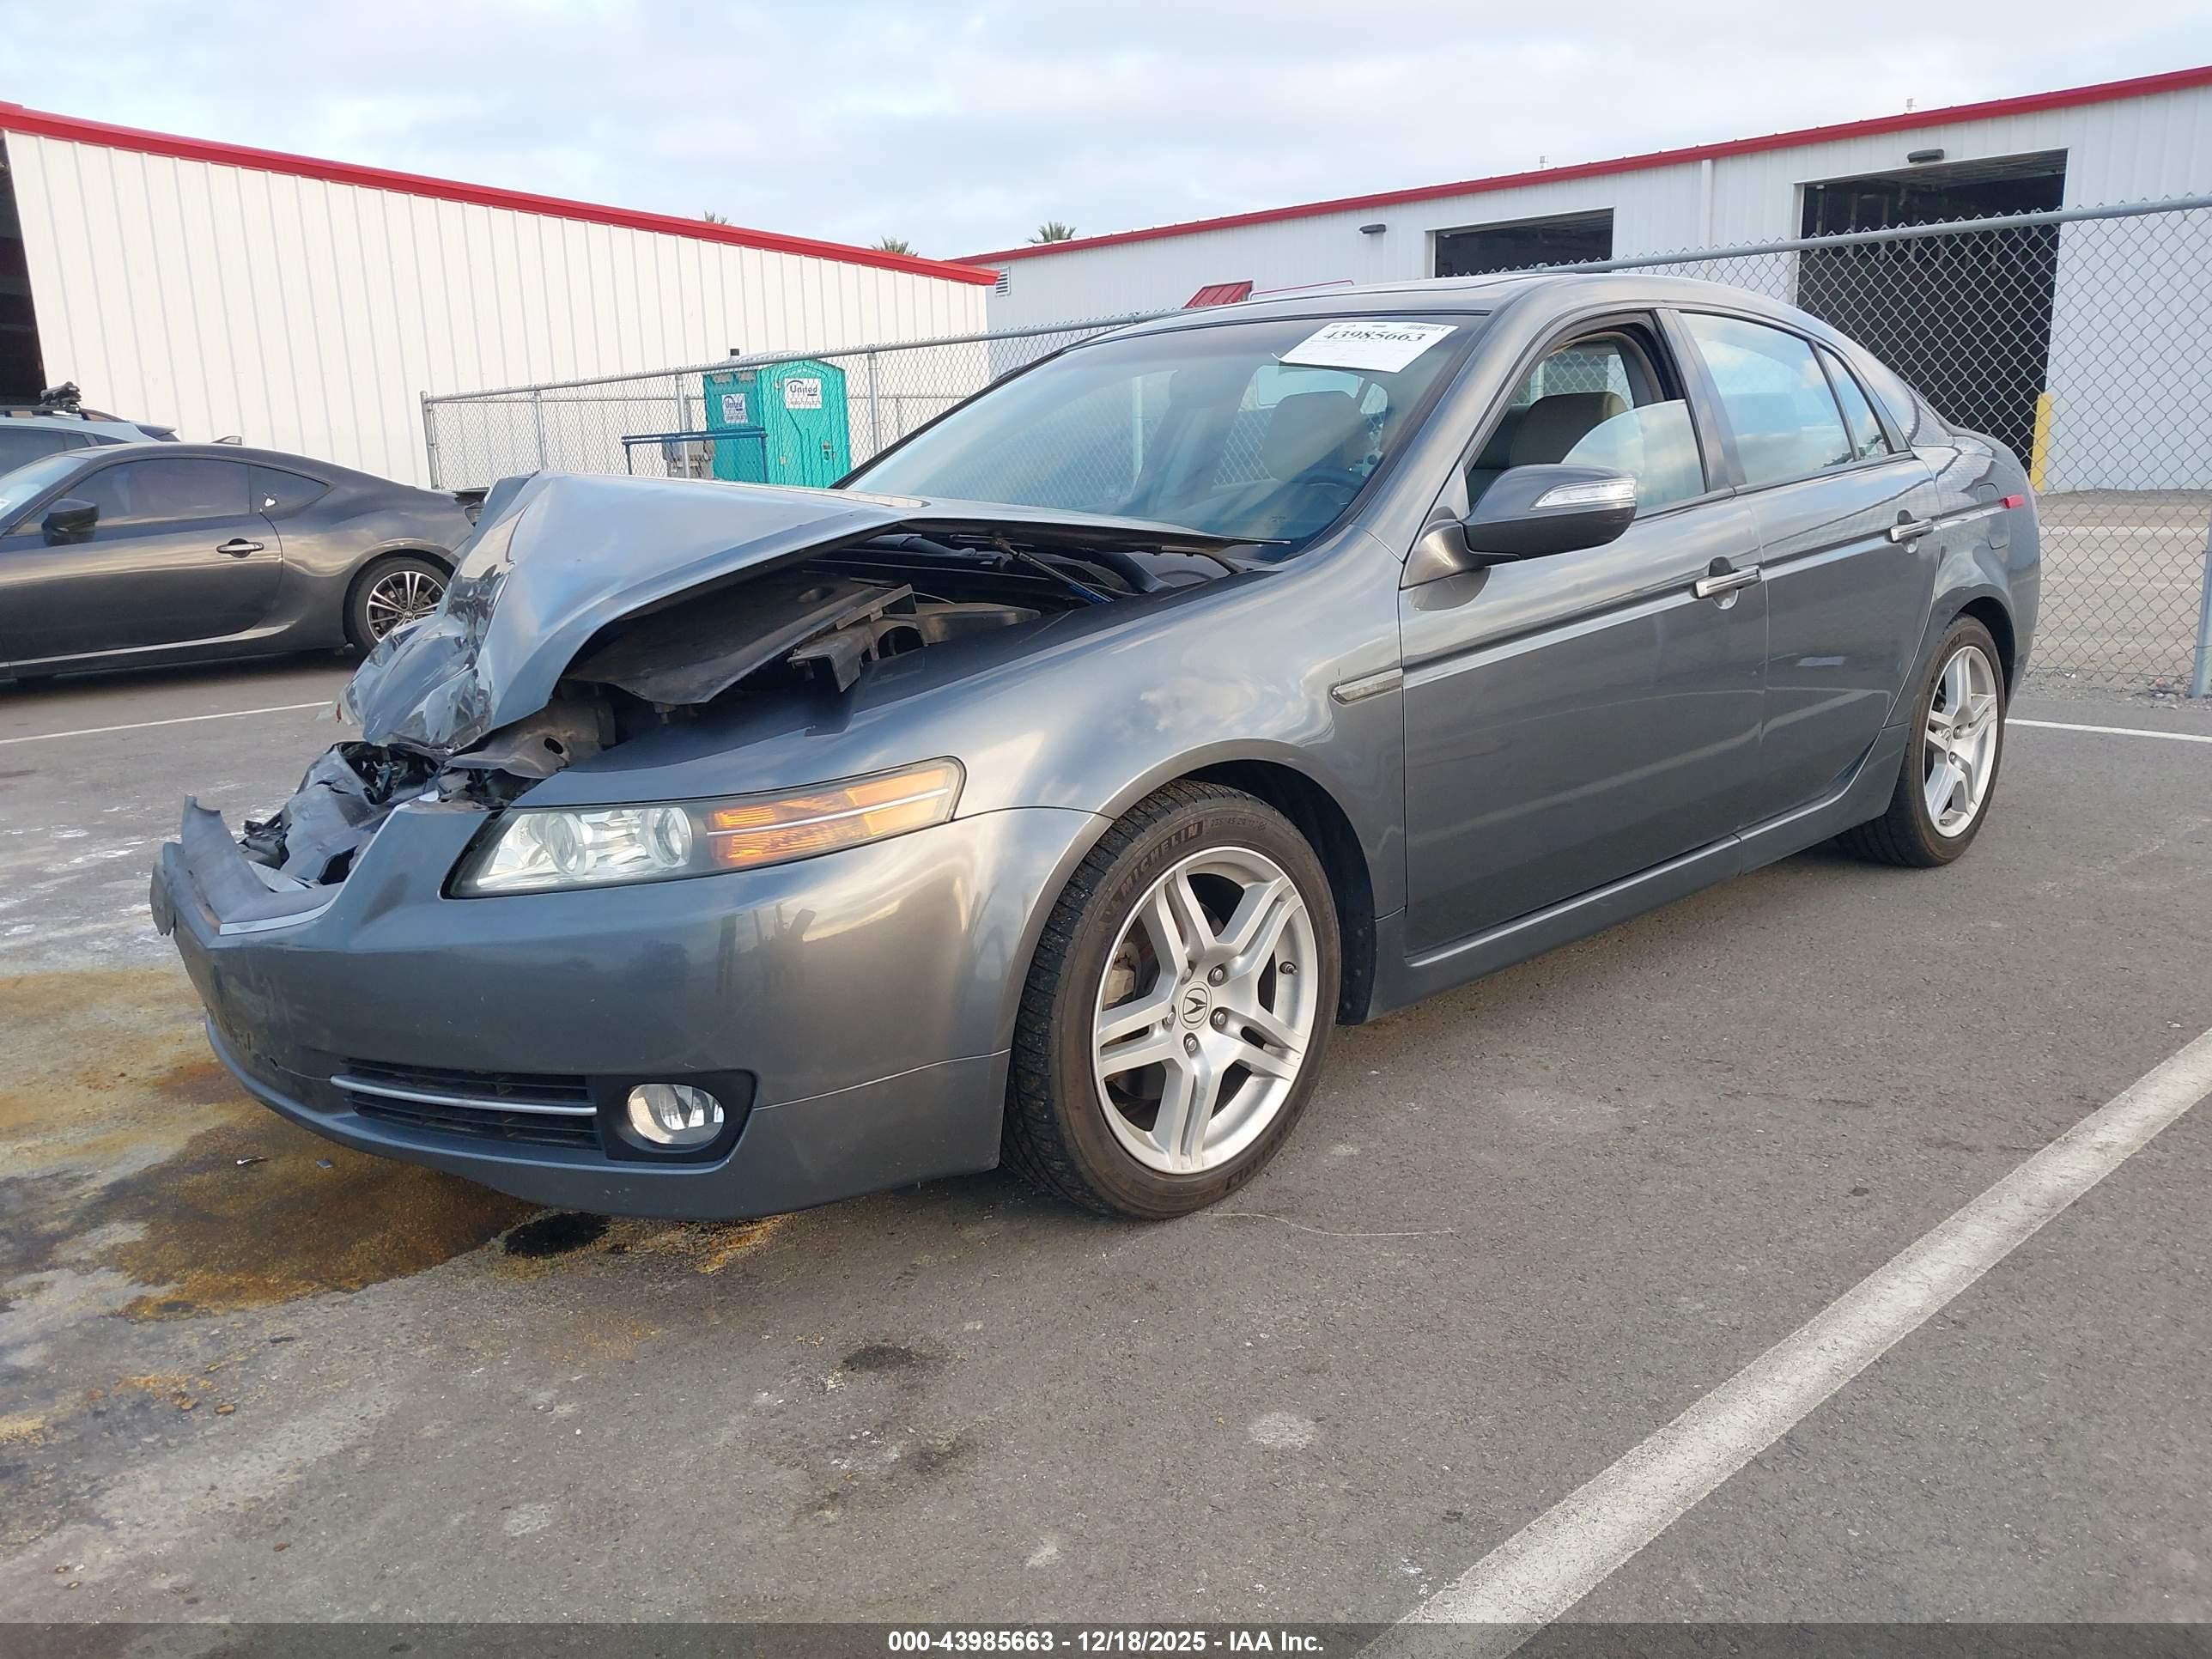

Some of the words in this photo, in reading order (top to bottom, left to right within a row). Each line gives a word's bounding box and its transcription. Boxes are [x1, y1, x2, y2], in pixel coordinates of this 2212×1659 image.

[1323, 330, 1426, 342] 43985663
[790, 384, 817, 393] United
[1120, 822, 1200, 896] MICHELIN
